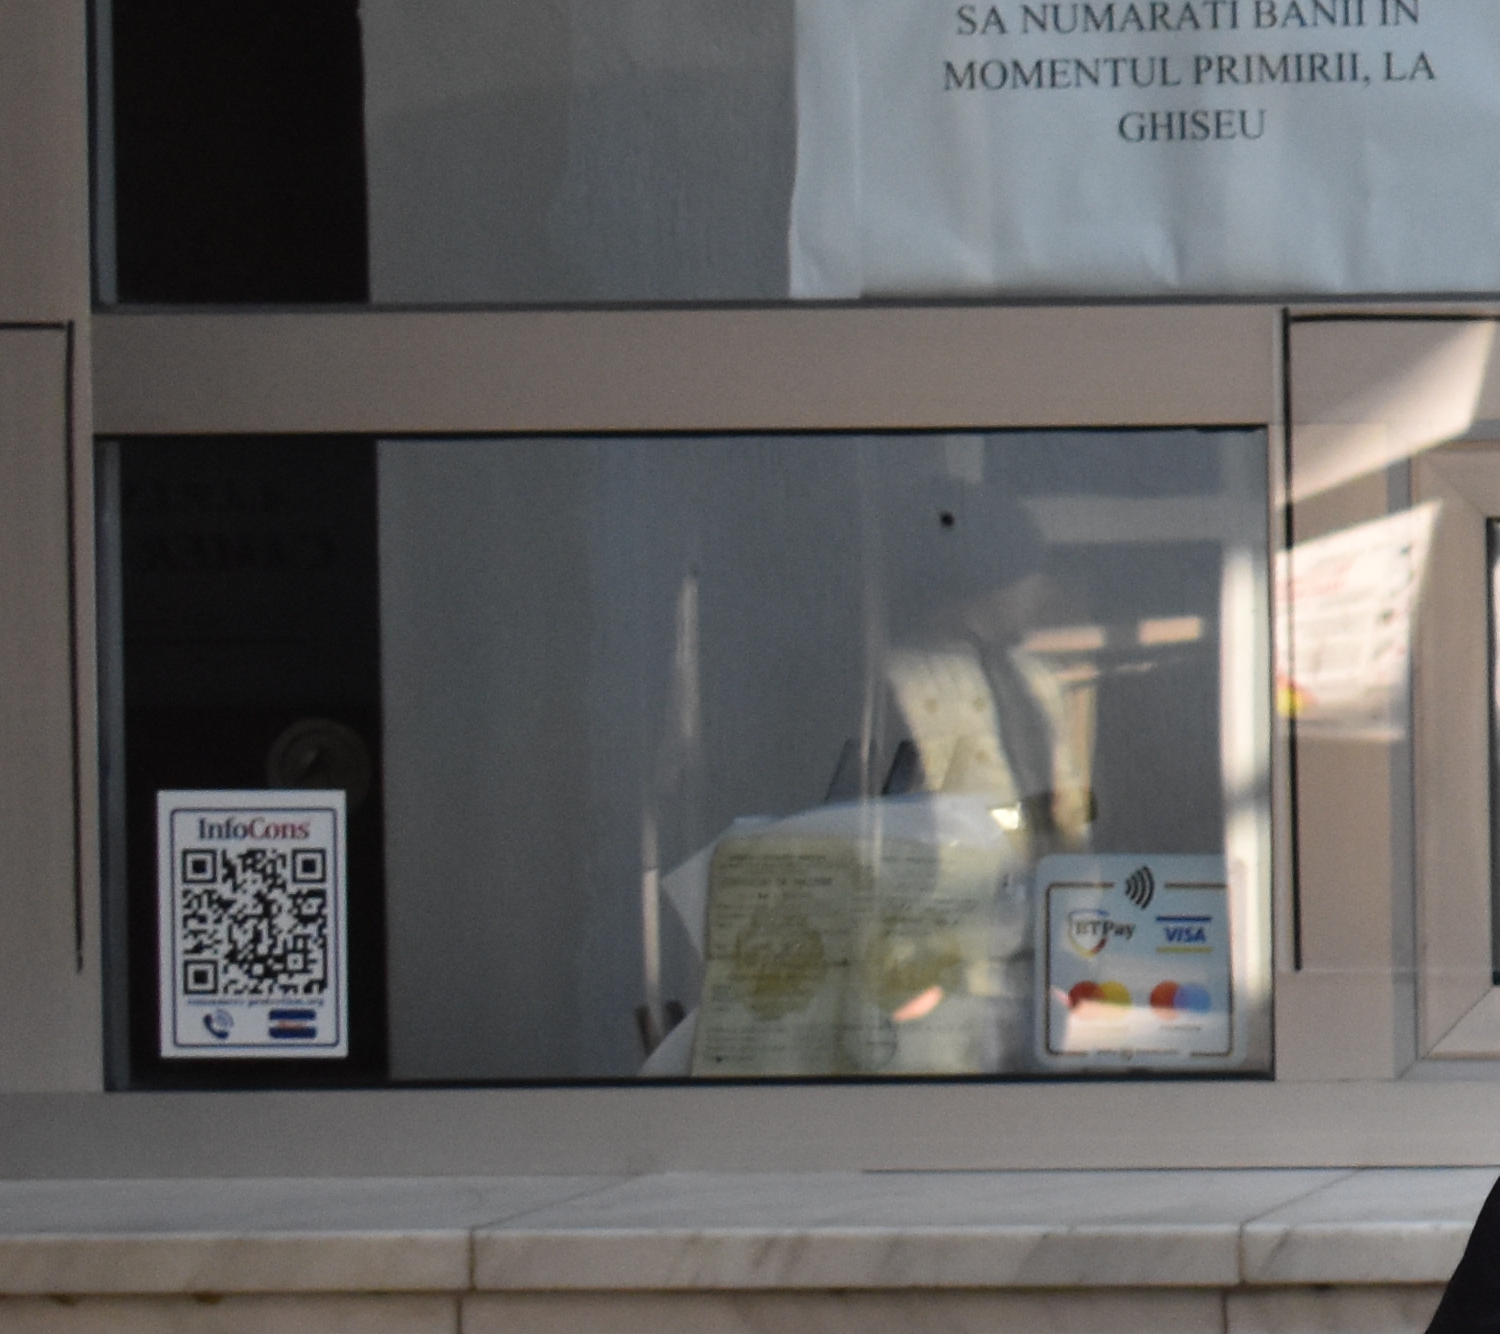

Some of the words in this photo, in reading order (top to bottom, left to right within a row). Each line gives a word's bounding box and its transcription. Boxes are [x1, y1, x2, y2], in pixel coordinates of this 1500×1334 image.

[957, 6, 1007, 34] SA
[1022, 0, 1238, 33] NUMARATI
[945, 57, 1180, 90] MOMENTUL
[1194, 52, 1370, 85] PRIMIRII,
[1385, 52, 1435, 81] LA
[1118, 110, 1264, 142] GHISEU
[199, 816, 310, 840] InfoCons
[1165, 928, 1206, 942] VISA
